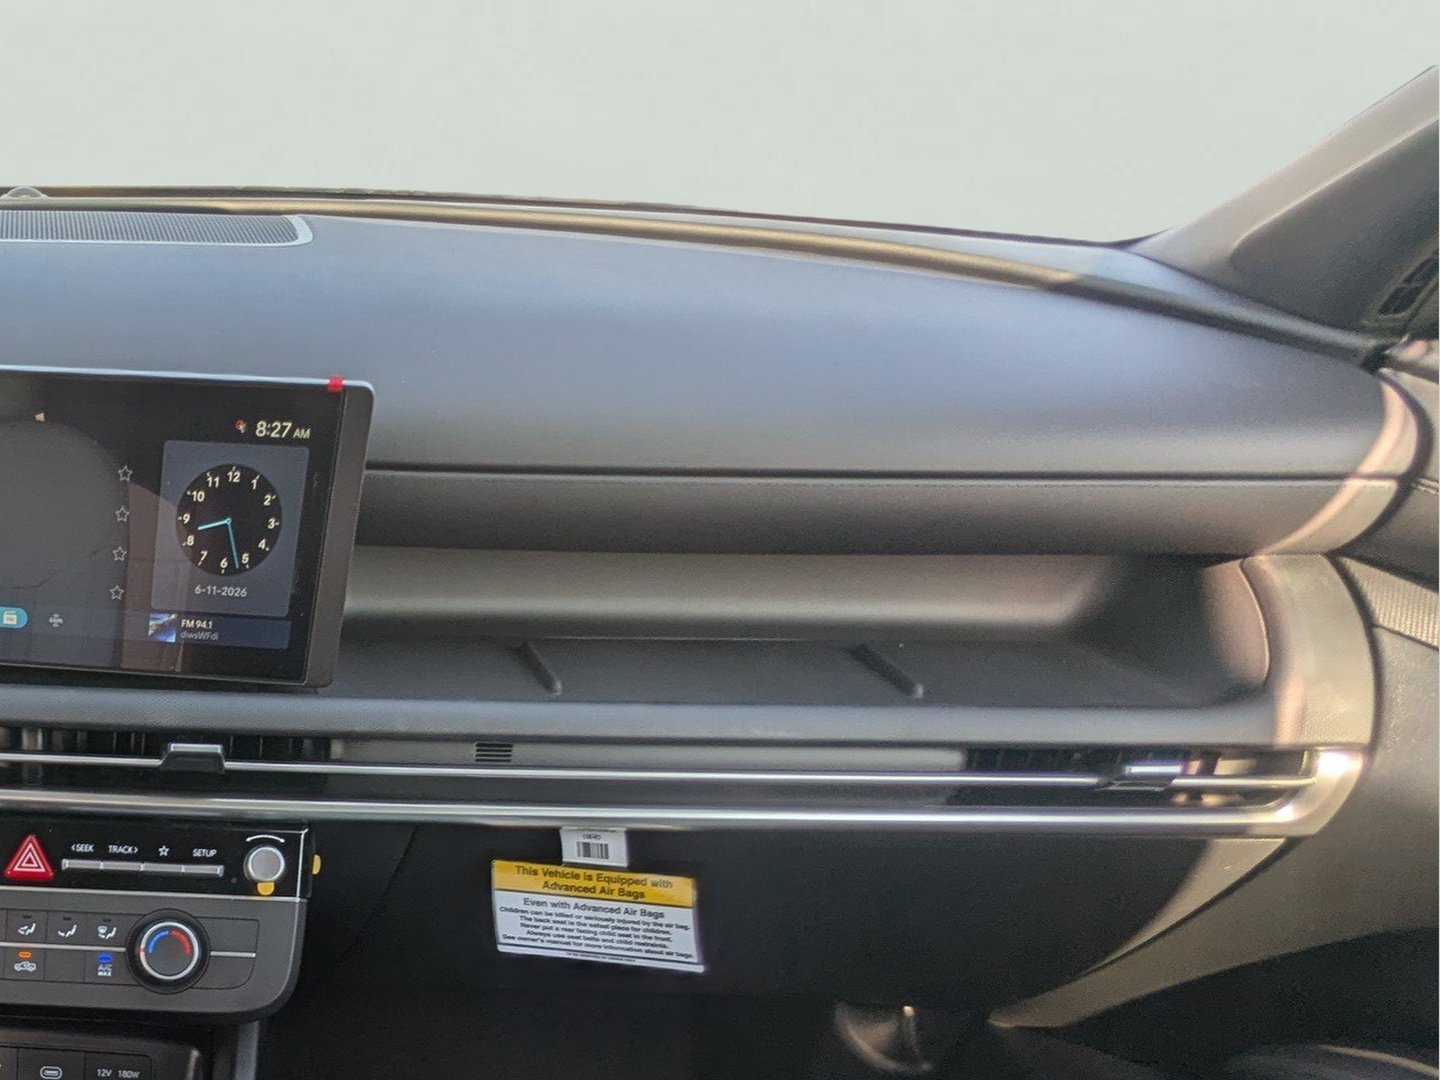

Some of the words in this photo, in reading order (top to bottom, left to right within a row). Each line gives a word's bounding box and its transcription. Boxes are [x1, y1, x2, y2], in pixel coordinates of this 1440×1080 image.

[255, 421, 293, 438] 8:27
[293, 427, 311, 439] AM
[207, 476, 220, 487] 11
[227, 471, 240, 483] 12
[191, 491, 205, 502] 10
[264, 494, 272, 506] 2
[182, 513, 190, 524] 9
[268, 518, 275, 529] 3
[187, 535, 194, 546] 8
[258, 538, 266, 550] 4
[200, 551, 208, 562] 7
[242, 553, 249, 564] 5
[220, 557, 228, 569] 6
[194, 584, 248, 597] 6-11-2026
[181, 619, 194, 628] FM
[196, 620, 213, 629] 94.1
[193, 848, 217, 857] SETUP
[515, 865, 538, 876] This
[542, 868, 580, 880] Vehicle
[583, 871, 593, 881] is
[596, 873, 647, 887] Equipped
[650, 879, 673, 889] with
[542, 881, 596, 894] Advanced
[599, 886, 614, 896] Air
[618, 888, 645, 900] Bags
[523, 897, 548, 908] Even
[550, 900, 571, 910] with
[573, 902, 621, 915] Advanced
[623, 907, 638, 916] Air
[640, 908, 665, 920] Bags
[97, 1069, 112, 1078] 12V
[118, 1069, 140, 1079] 180W
